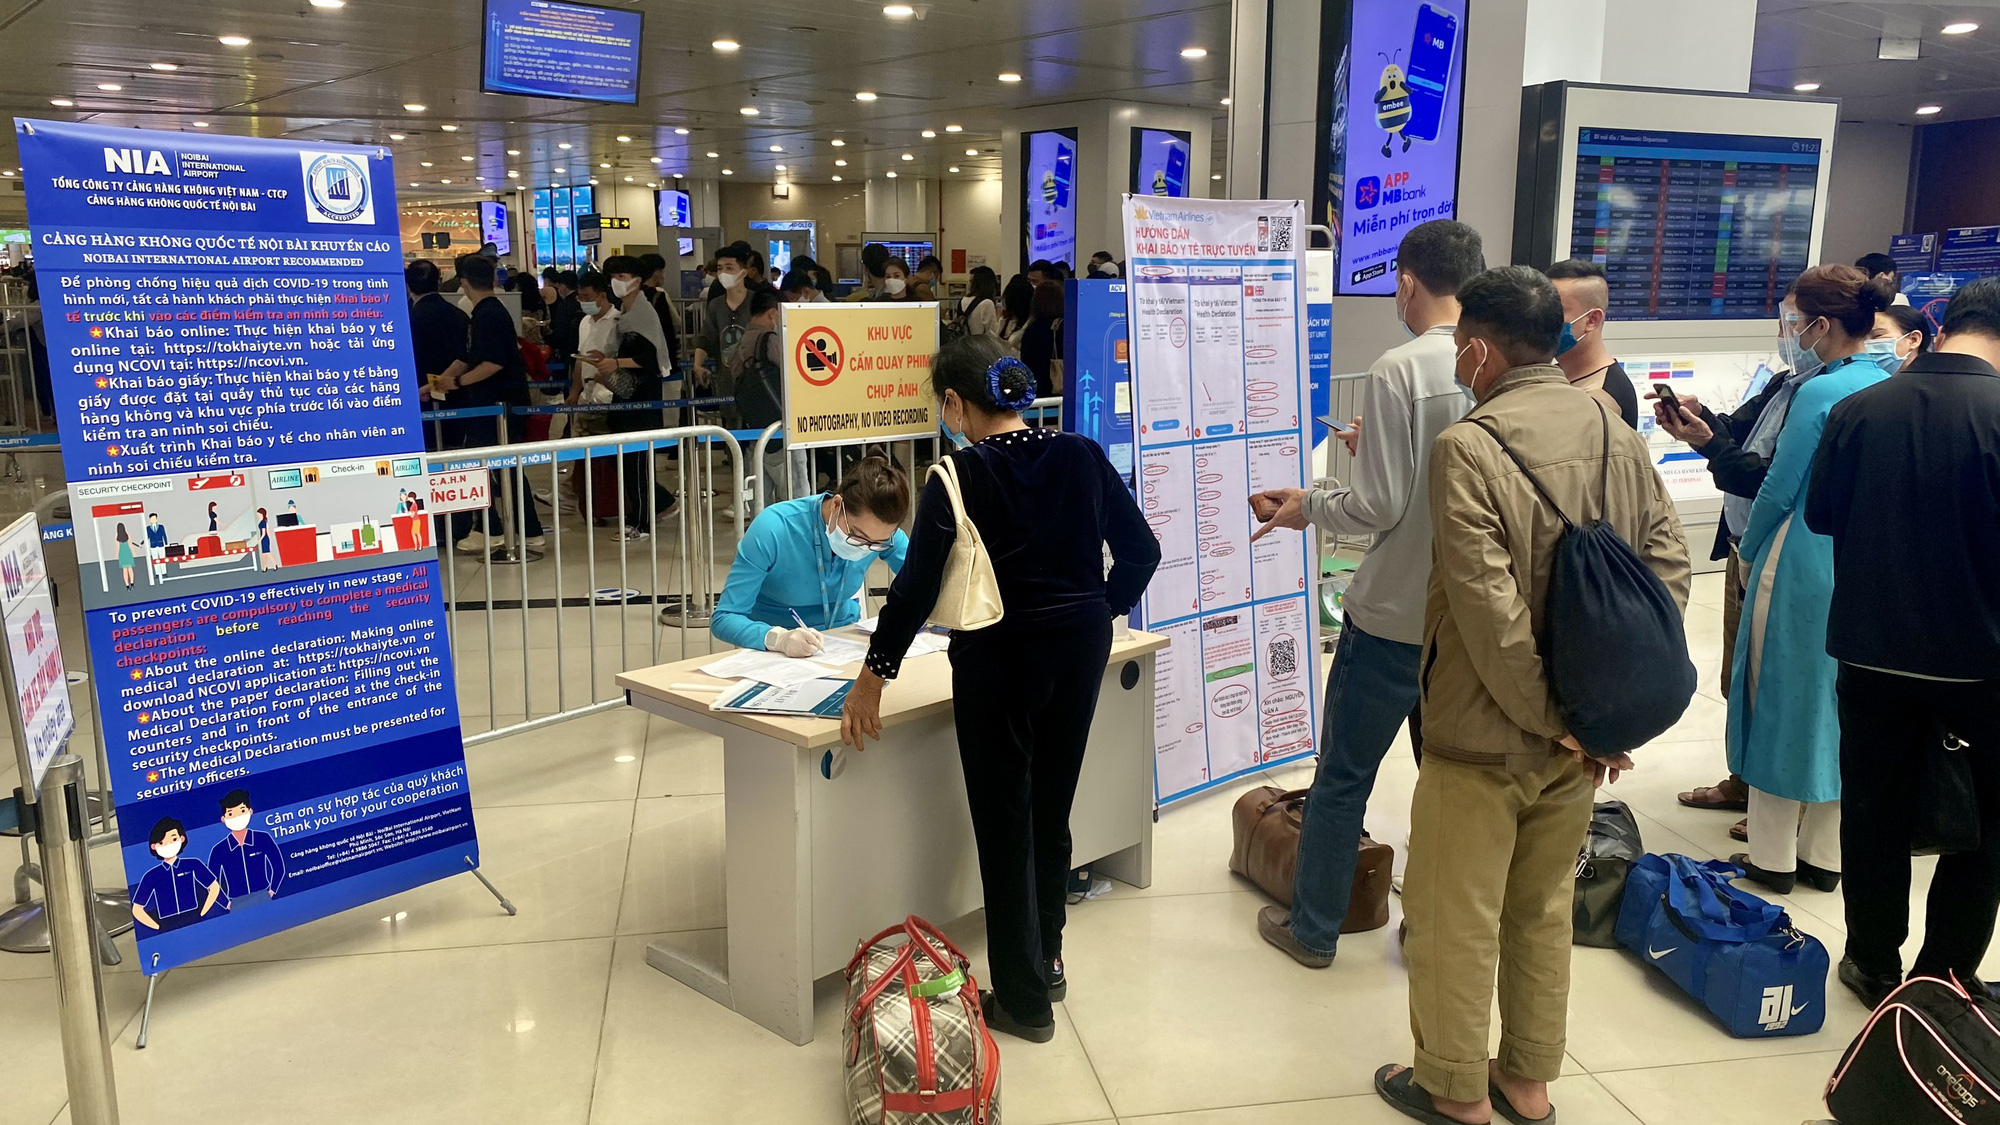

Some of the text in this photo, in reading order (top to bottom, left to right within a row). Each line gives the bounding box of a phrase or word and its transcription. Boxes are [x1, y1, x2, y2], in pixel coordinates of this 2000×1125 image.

[1432, 38, 1445, 49] MB
[1383, 100, 1404, 110] embee
[104, 148, 171, 175] NIA
[181, 153, 209, 162] NOIBAI
[182, 162, 246, 172] INTERNATIONAL
[183, 170, 219, 179] AIRPORT
[1384, 172, 1410, 189] APP
[52, 176, 79, 188] TỔNG
[82, 179, 109, 190] CÔNG
[111, 182, 123, 190] TY
[126, 180, 152, 192] CẢNG
[155, 183, 180, 193] HÀNG
[184, 184, 215, 195] KHÔNG
[217, 186, 236, 198] VIỆT
[240, 188, 259, 197] NAM
[267, 190, 287, 198] CTCP
[329, 169, 349, 196] ACI
[1354, 200, 1454, 237] Miễn phí trọn đời
[1135, 226, 1169, 239] HƯỚNG
[43, 232, 390, 252] CẢNG HÀNG KHÔNG QUỐC TẾ NỘI BÀI KHUYẾN CÁO
[1136, 241, 1256, 258] KHAI BÁO Y TẾ TRỰC TUYẾN
[83, 254, 364, 266] NOIBAI INTERNATIONAL AIRPORT RECOMMENDED
[61, 276, 388, 290] Để phòng chống hiệu quả dịch COVID-19 trong tình
[868, 325, 912, 344] KHU VỰC
[850, 351, 930, 372] CẤM QUAY PHIM
[867, 378, 918, 402] CHỤP ẢNH
[797, 407, 928, 433] NO PHOTOGRAPHY, NO VIDEO RECORDING
[1239, 420, 1244, 432] 2
[1292, 415, 1297, 427] 3
[1186, 426, 1190, 437] 1
[331, 463, 365, 474] Check-in
[271, 473, 300, 485] AIRLINE
[430, 475, 466, 486] C.A.H.N
[78, 481, 172, 497] SECURITY CHECKPOINT
[460, 486, 484, 501] LẠI
[1298, 577, 1303, 589] 6
[109, 567, 426, 623] To prevent COVID-19 effectively in new stage All
[1245, 587, 1251, 599] 5
[1192, 598, 1198, 610] 4
[1254, 751, 1259, 763] 8
[1202, 767, 1207, 780] 7
[271, 782, 458, 838] Thank you for your cooperation
